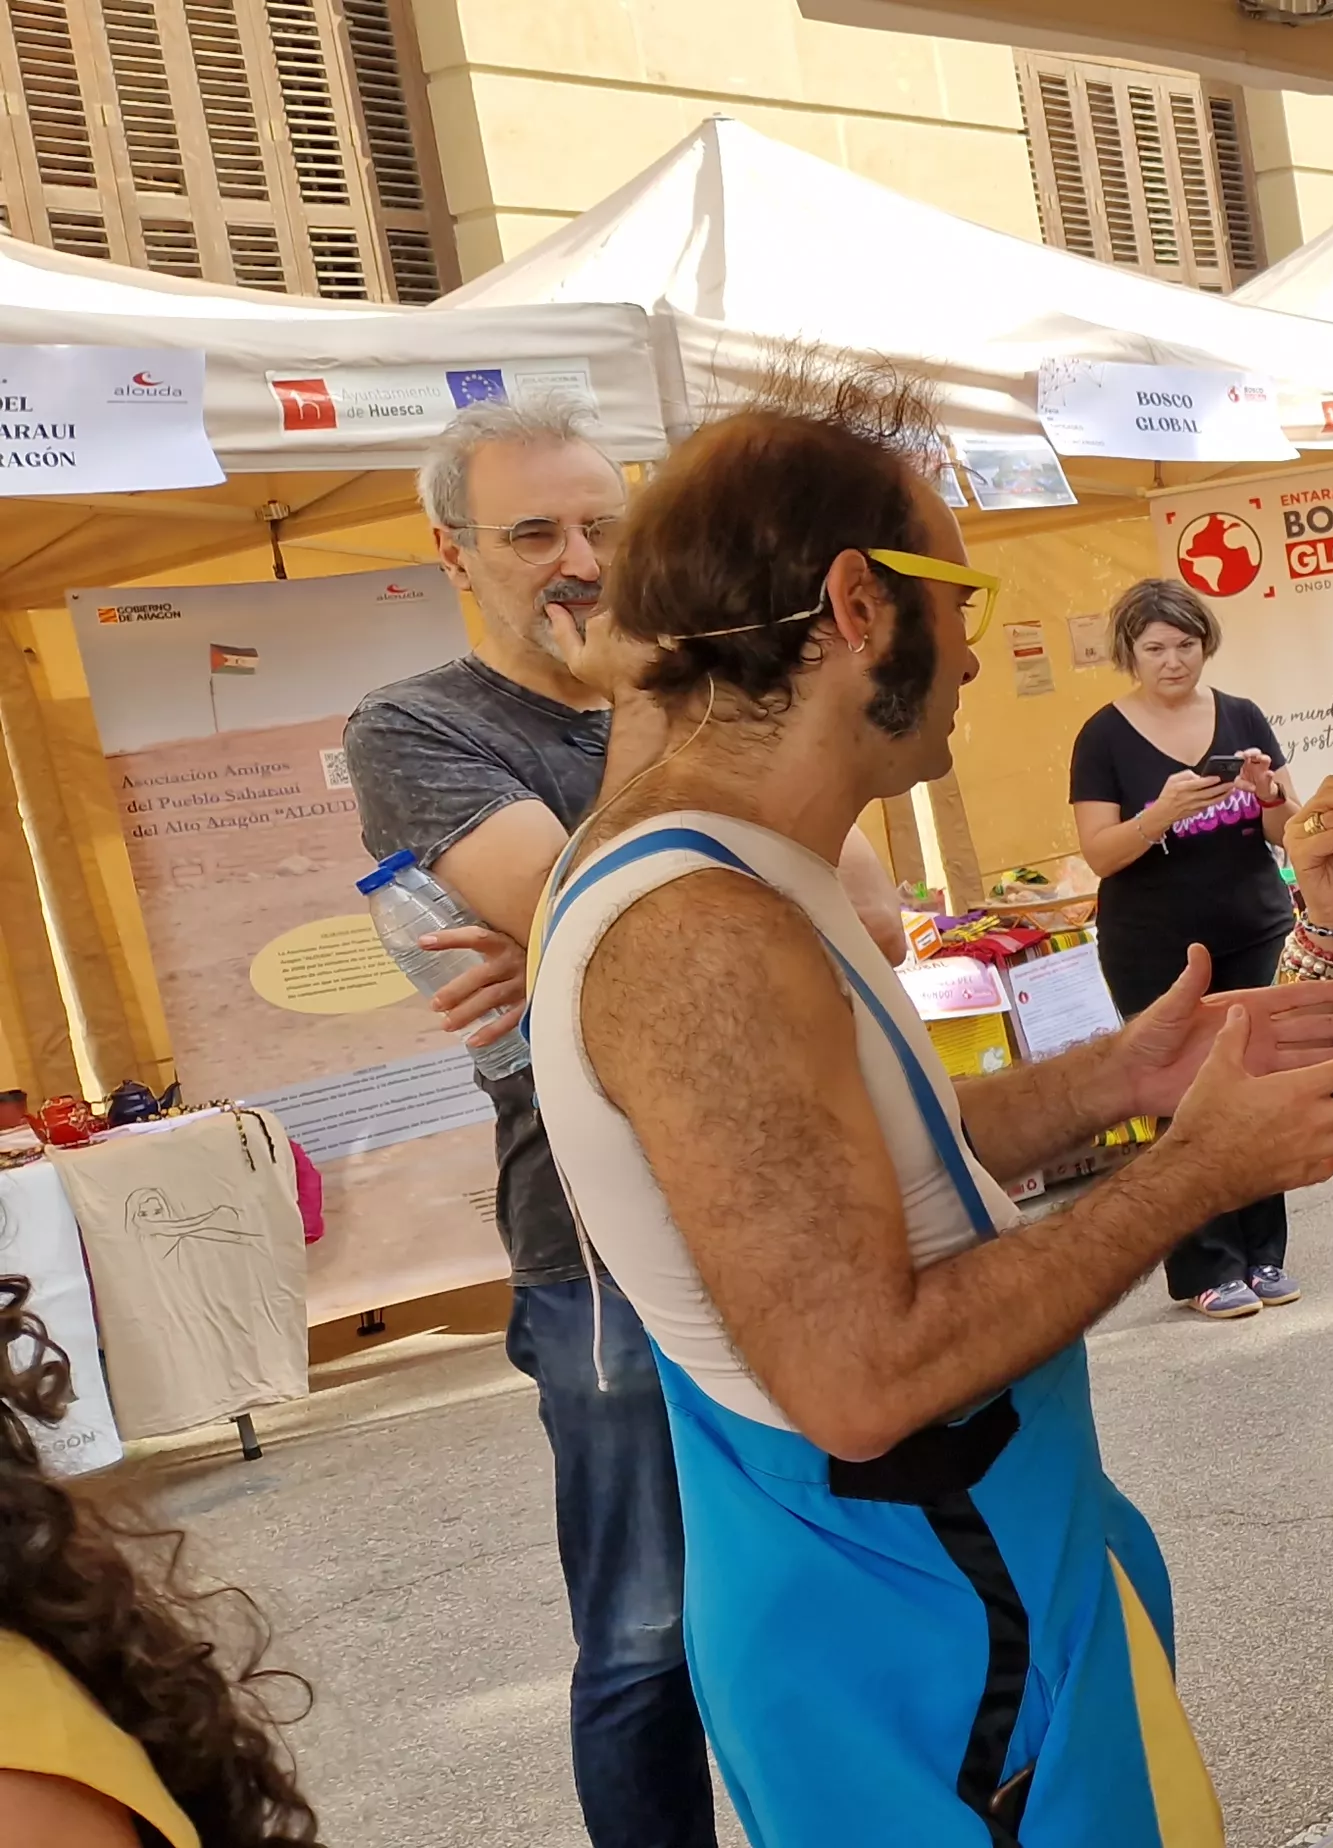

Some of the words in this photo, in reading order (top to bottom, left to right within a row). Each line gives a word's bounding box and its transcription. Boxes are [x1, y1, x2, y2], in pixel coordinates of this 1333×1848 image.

[113, 385, 183, 398] alouda
[339, 385, 441, 402] Ayuntamiento
[1136, 390, 1193, 409] BOSCO
[346, 405, 364, 419] de
[369, 402, 424, 418] Huesca
[1135, 416, 1203, 434] GLOBAL
[1294, 579, 1332, 595] ONGD
[1286, 740, 1300, 765] y
[223, 760, 292, 779] Amigos
[127, 797, 153, 814] del
[158, 793, 221, 811] Pueblo
[224, 784, 301, 803] Saharaui
[132, 822, 159, 839] del
[164, 819, 201, 835] Alto
[206, 811, 271, 829] Aragón
